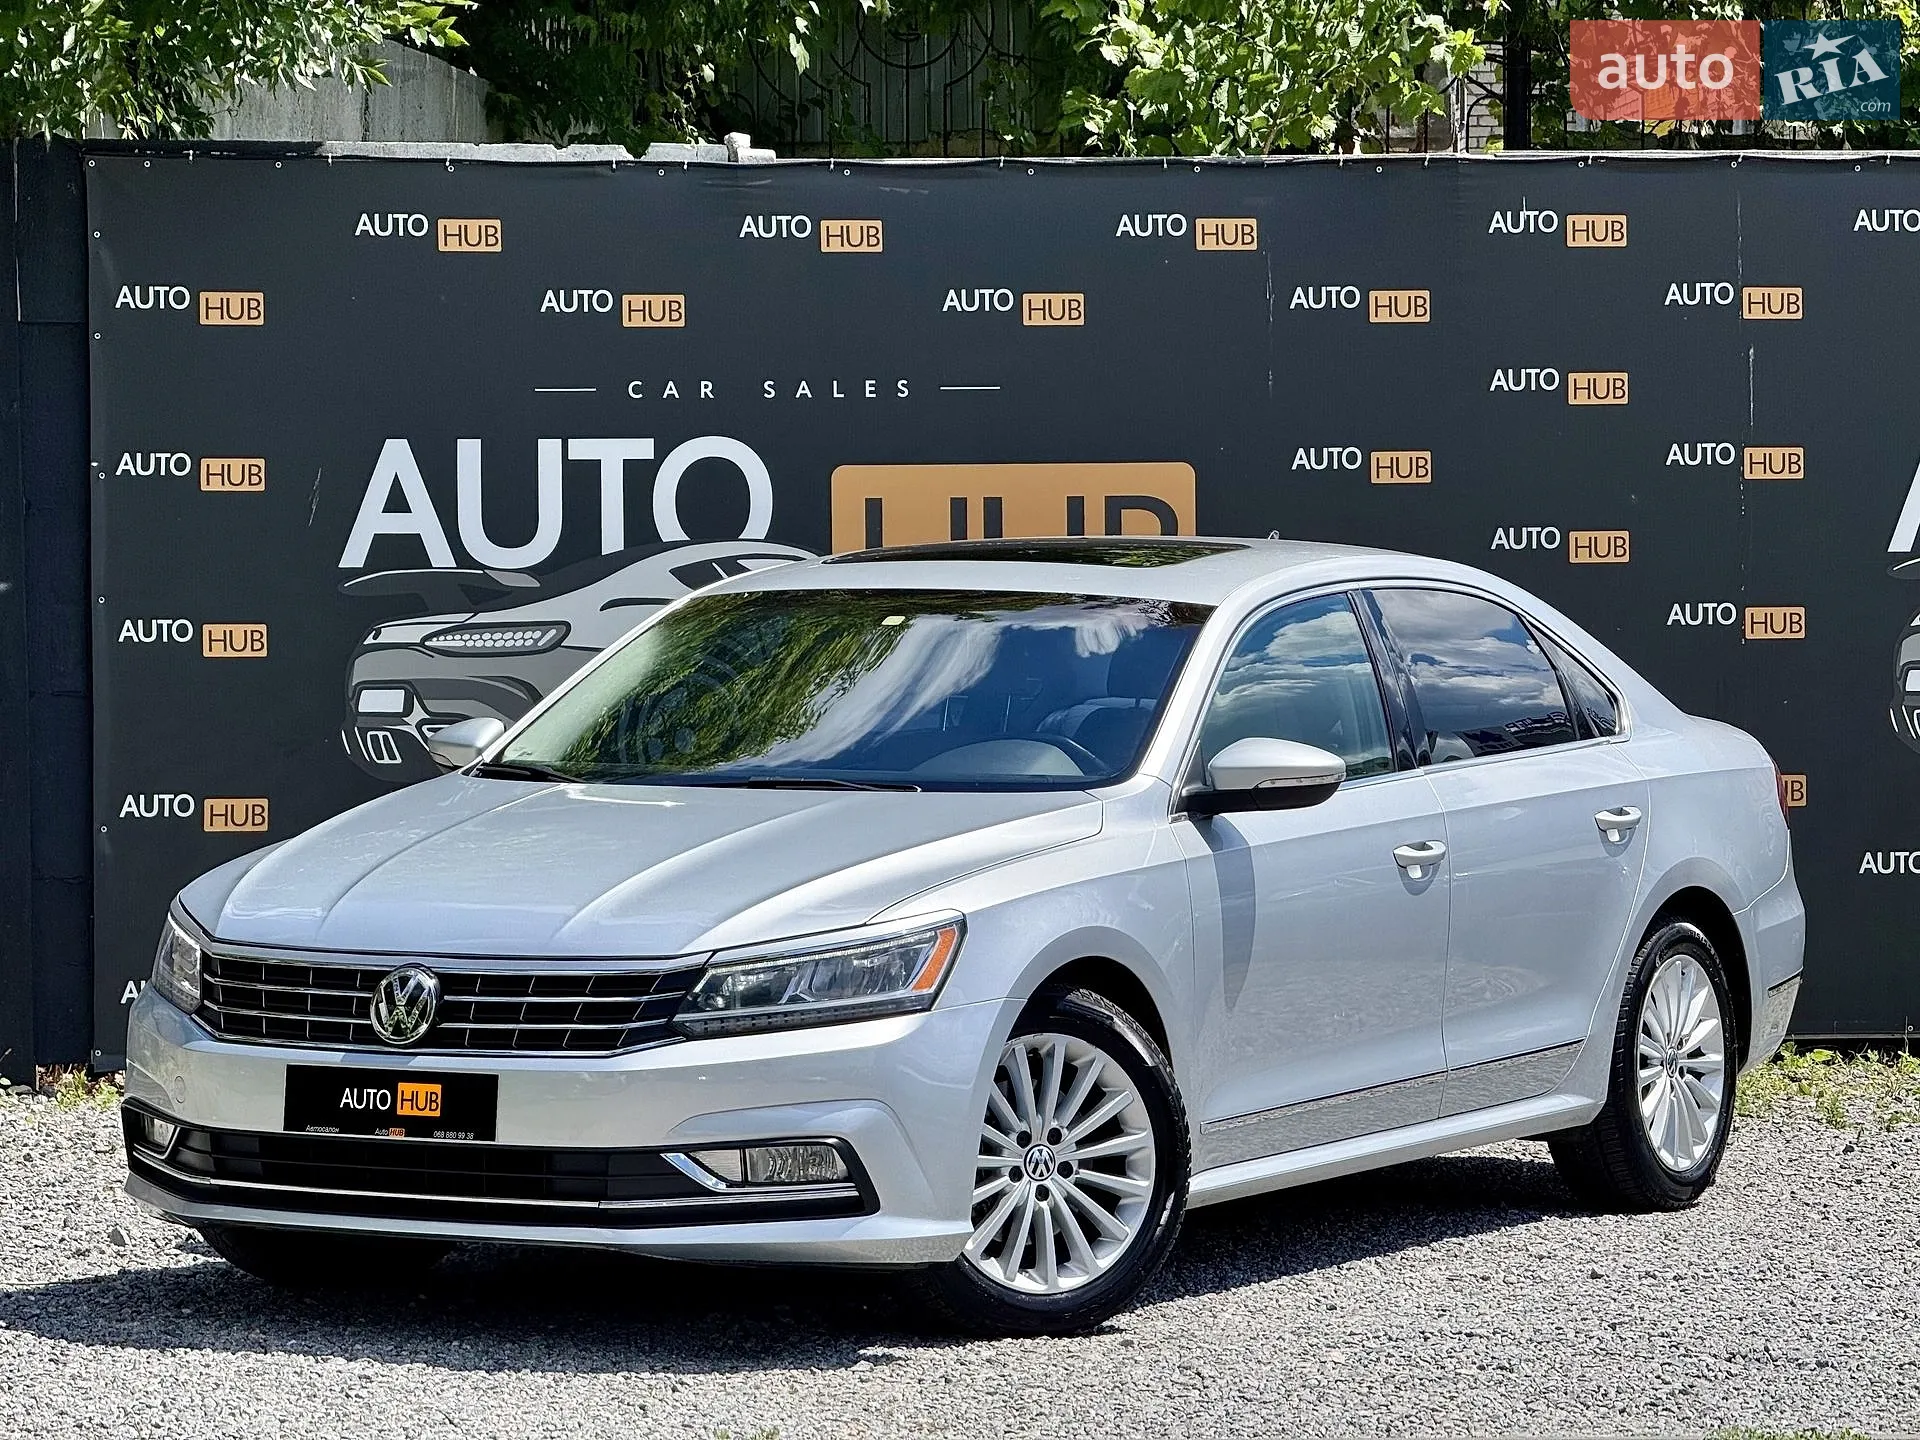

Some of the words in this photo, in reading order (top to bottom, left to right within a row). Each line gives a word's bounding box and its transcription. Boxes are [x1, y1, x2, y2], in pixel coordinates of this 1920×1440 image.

[355, 213, 428, 236] AUTO
[444, 225, 497, 246] HUB
[740, 215, 811, 238] AUTO
[826, 226, 878, 246] HUB
[1116, 214, 1187, 236] AUTO
[1202, 224, 1253, 245] HUB
[1489, 211, 1558, 233] AUTO
[1572, 220, 1622, 241] HUB
[1853, 209, 1920, 232] AUTO
[115, 286, 190, 309] AUTO
[206, 298, 260, 320] HUB
[541, 290, 613, 312] AUTO
[628, 300, 681, 322] HUB
[942, 289, 1013, 311] AUTO
[1029, 299, 1080, 320] HUB
[1290, 286, 1360, 309] AUTO
[1375, 296, 1425, 317] HUB
[1665, 282, 1734, 305] AUTO
[1748, 293, 1798, 313] HUB
[628, 380, 714, 399] CAR
[763, 380, 909, 399] SALES
[1490, 368, 1559, 391] AUTO
[1574, 378, 1624, 399] HUB
[116, 453, 191, 476] AUTO
[206, 464, 261, 486] HUB
[1292, 447, 1362, 470] AUTO
[1377, 457, 1427, 478] HUB
[1666, 443, 1735, 465] AUTO
[1750, 453, 1800, 474] HUB
[338, 436, 773, 569] AUTO
[1491, 527, 1560, 549] AUTO
[1575, 536, 1626, 558] HUB
[1667, 603, 1736, 625] AUTO
[1751, 613, 1801, 634] HUB
[118, 619, 193, 642] AUTO
[209, 630, 263, 652] HUB
[120, 794, 194, 817] AUTO
[210, 804, 265, 826] HUB
[340, 1087, 391, 1110] AUTO
[400, 1090, 439, 1112] HUB
